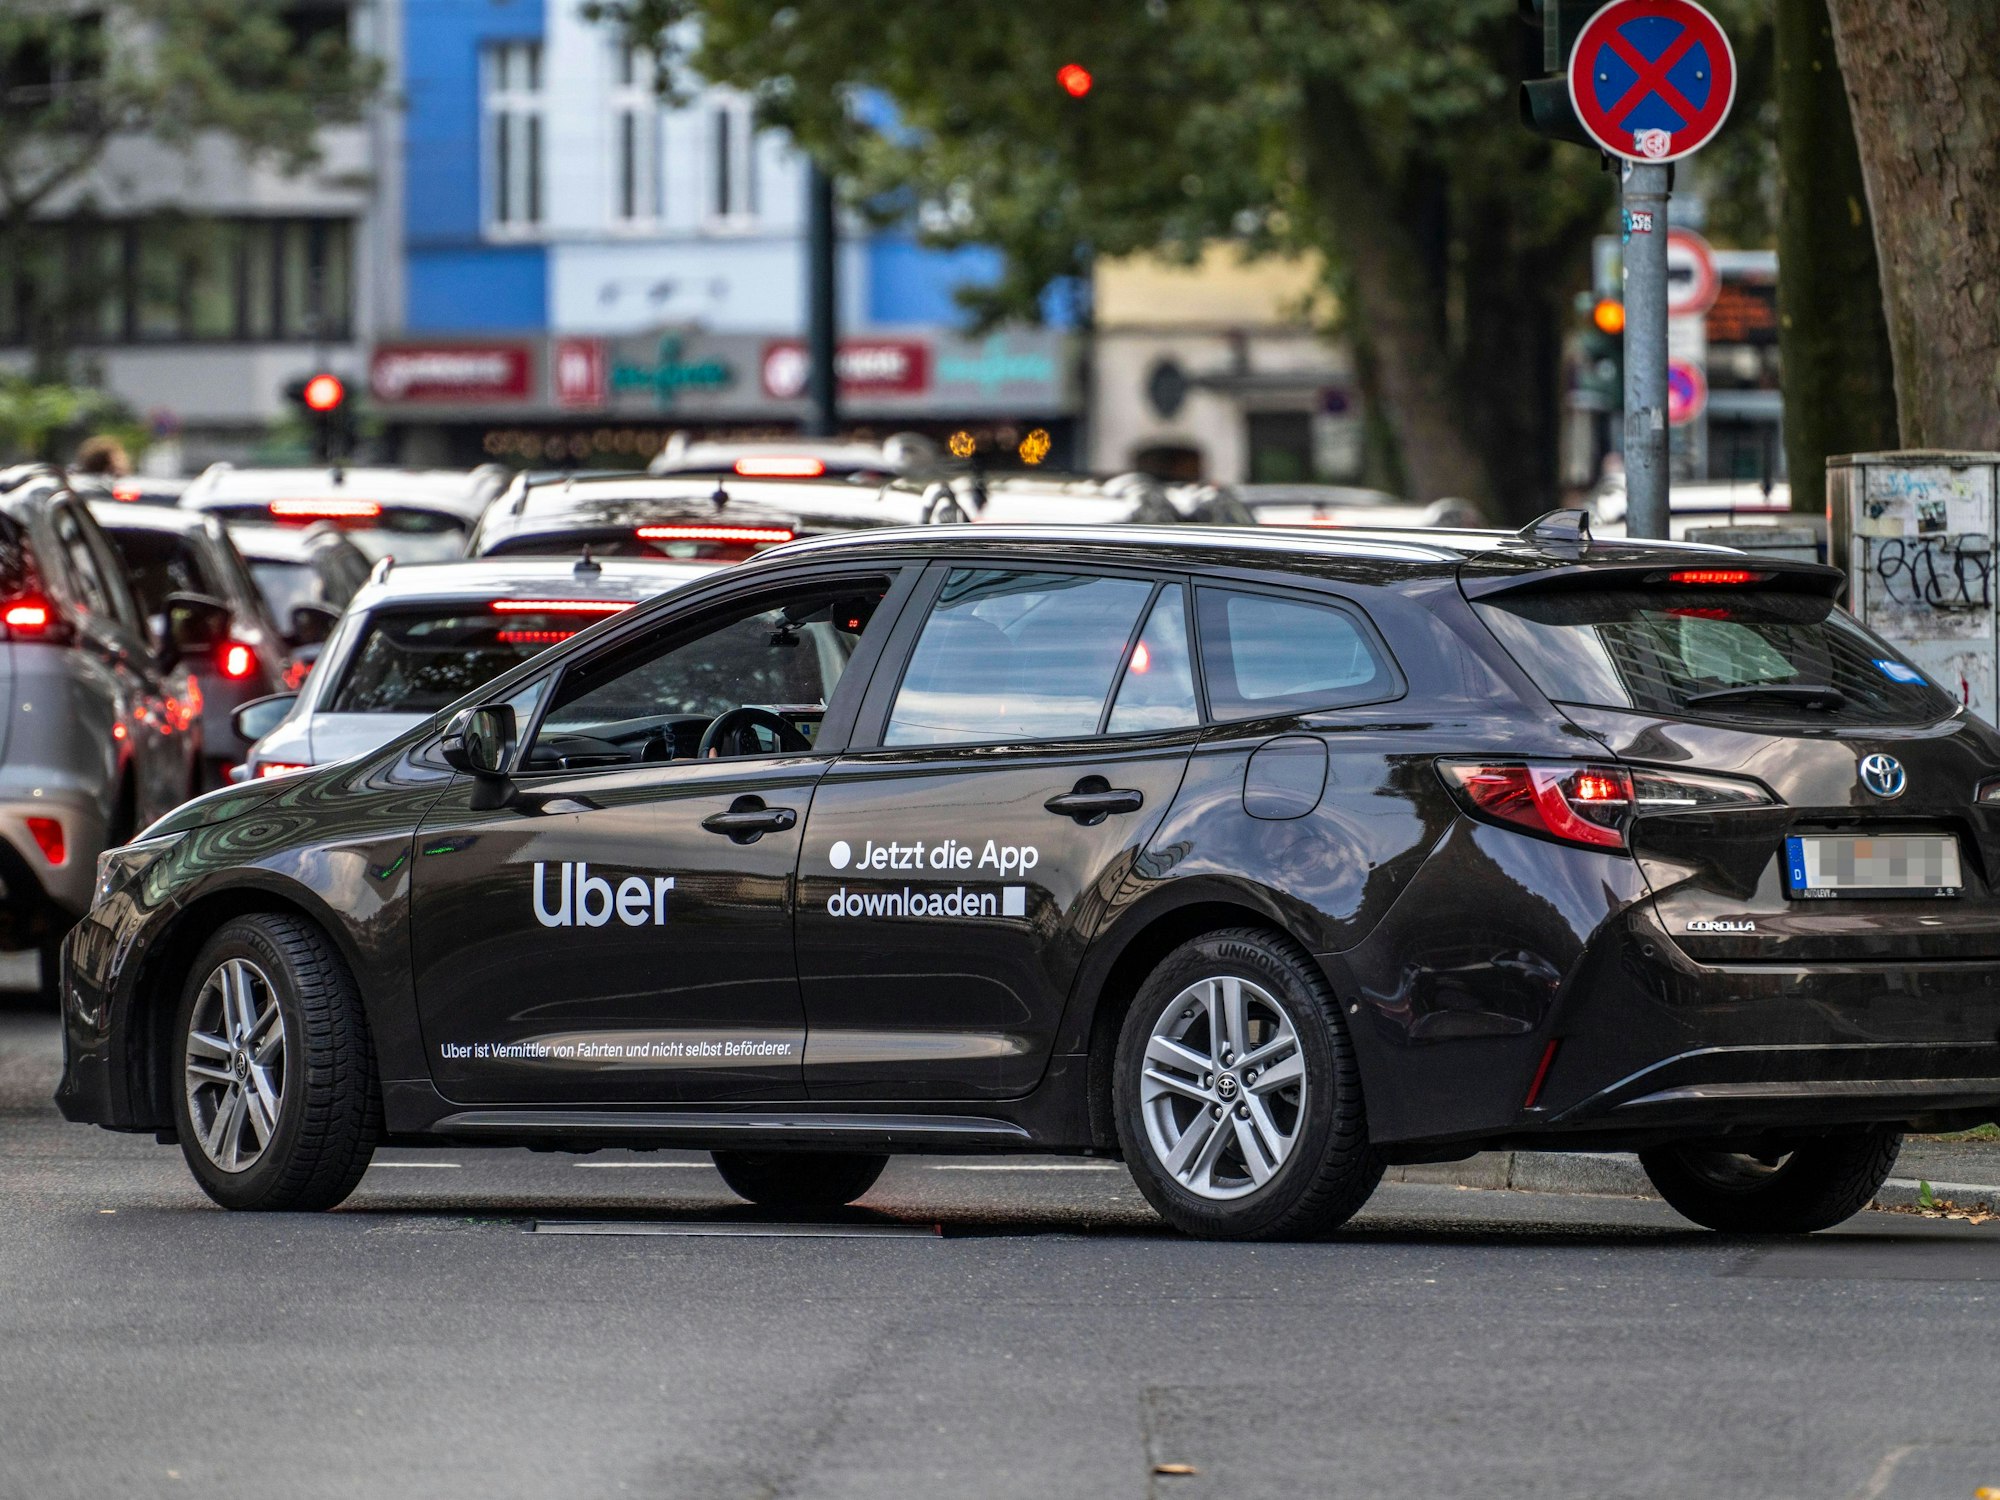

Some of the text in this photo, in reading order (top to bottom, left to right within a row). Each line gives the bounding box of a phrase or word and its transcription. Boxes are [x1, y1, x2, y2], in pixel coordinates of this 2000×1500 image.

[1632, 213, 1652, 221] FCK
[855, 839, 1039, 877] Jetzt die App
[1794, 868, 1801, 880] D
[533, 862, 674, 927] Uber
[827, 886, 996, 917] downloaden
[1687, 921, 1756, 932] COROLLA
[1218, 943, 1293, 991] UNIROYAL
[441, 1040, 792, 1058] Uber ist Vermittler von Fahrten und nicht selbst Beförderer.
